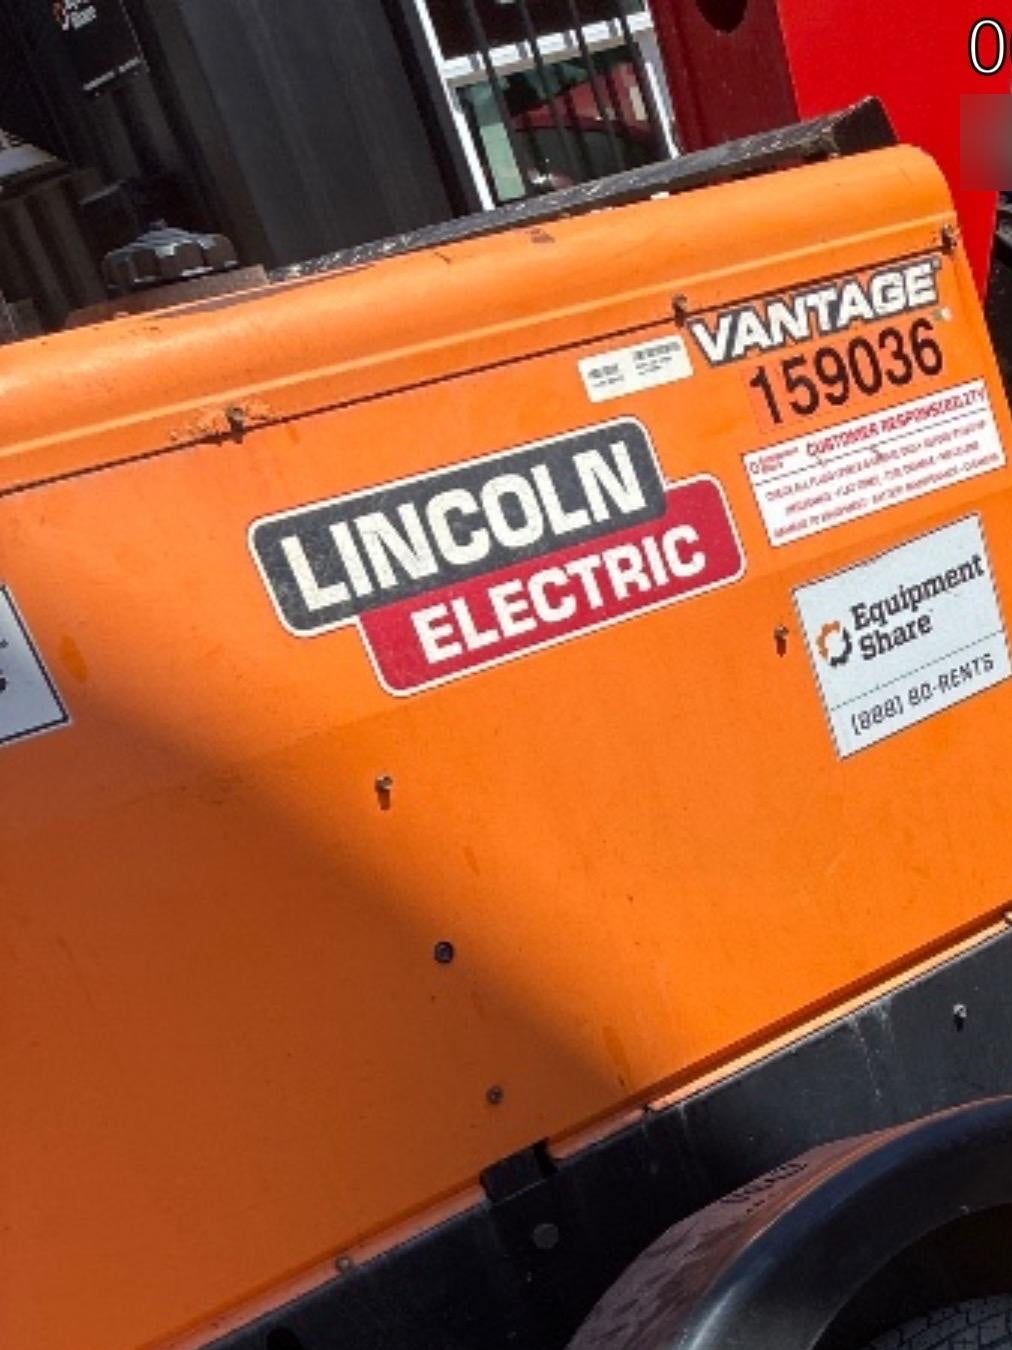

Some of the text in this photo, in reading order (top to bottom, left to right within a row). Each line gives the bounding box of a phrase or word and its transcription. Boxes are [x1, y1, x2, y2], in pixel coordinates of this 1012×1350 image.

[689, 259, 938, 366] VANTAGE
[750, 318, 943, 424] 159036
[280, 440, 647, 613] LINCOLN
[411, 524, 706, 665] ELECTRIC
[850, 553, 986, 631] Equipment
[858, 612, 933, 661] Share
[851, 653, 995, 735] (888) 80-RENTS
